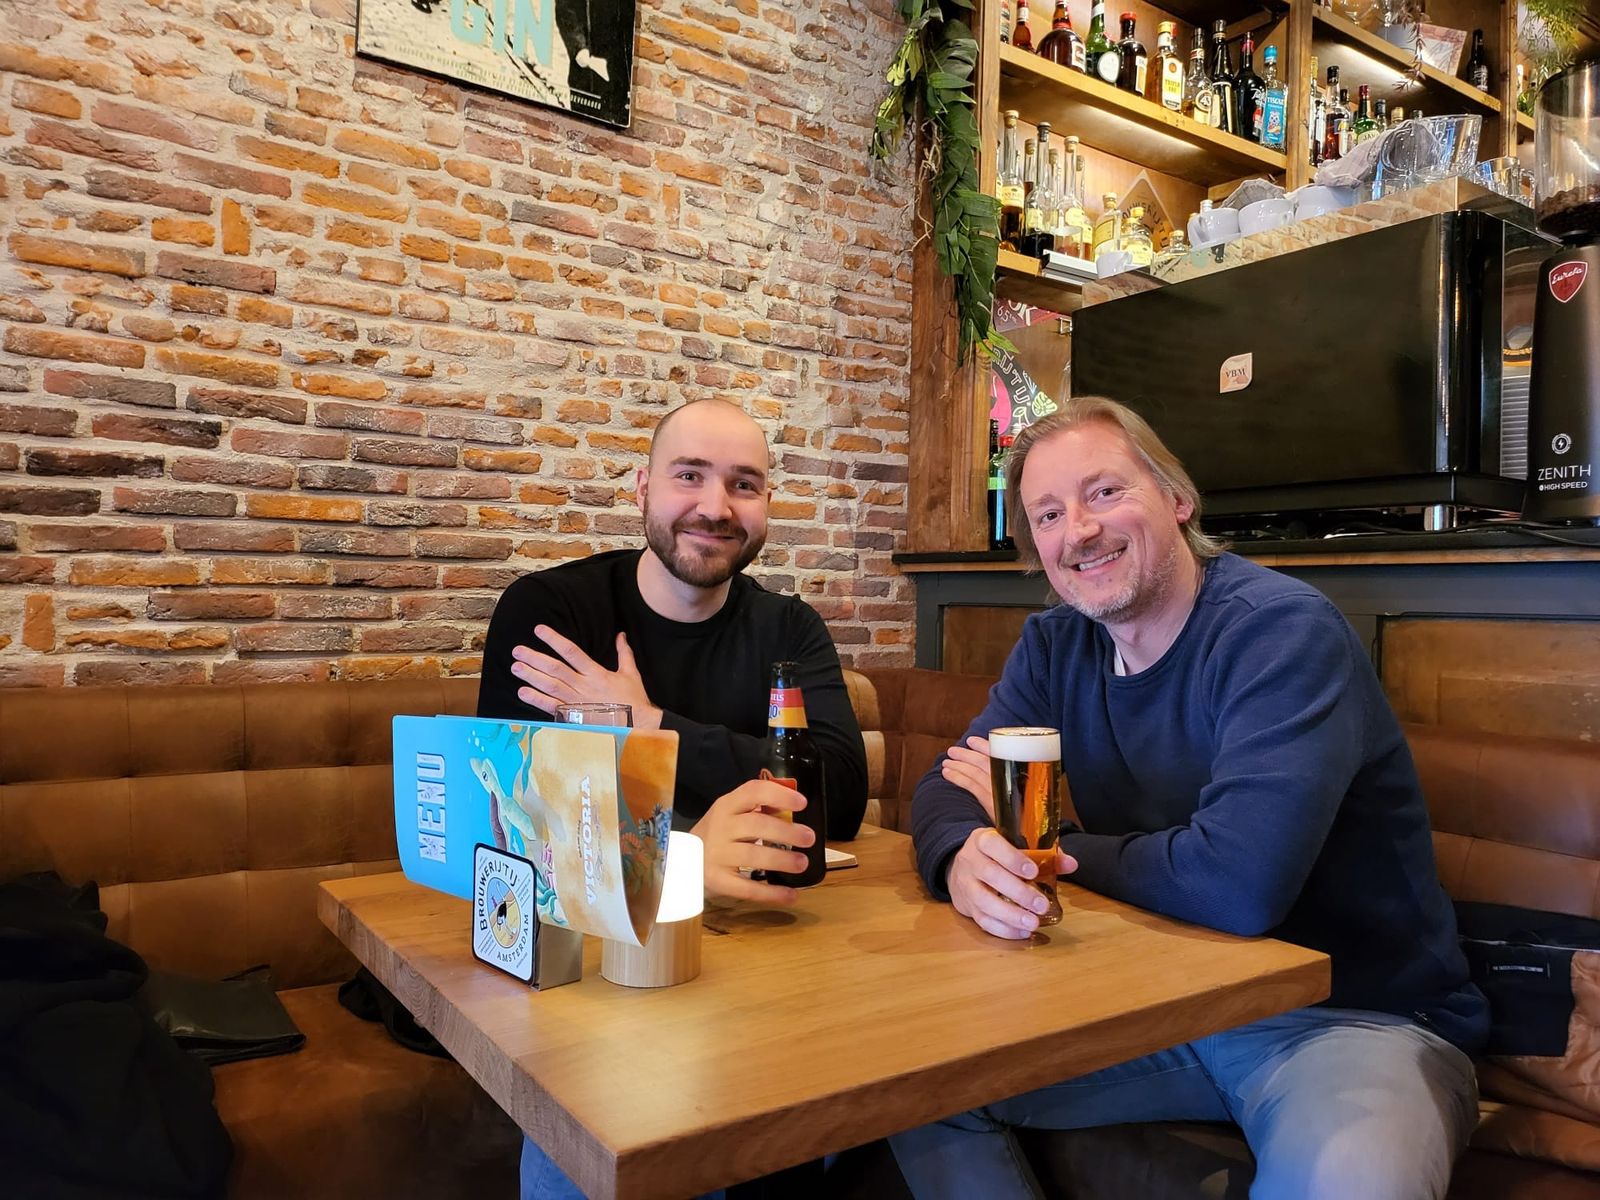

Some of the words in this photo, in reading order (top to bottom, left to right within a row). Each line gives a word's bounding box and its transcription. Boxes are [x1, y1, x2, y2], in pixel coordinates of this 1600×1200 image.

[450, 0, 555, 66] GIN
[1537, 464, 1591, 481] ZENITH
[1544, 483, 1561, 491] HIGH
[1561, 481, 1588, 490] SPEED
[416, 752, 447, 864] MENU
[580, 776, 597, 905] VICTORIA
[496, 914, 529, 963] AMSTERDAM
